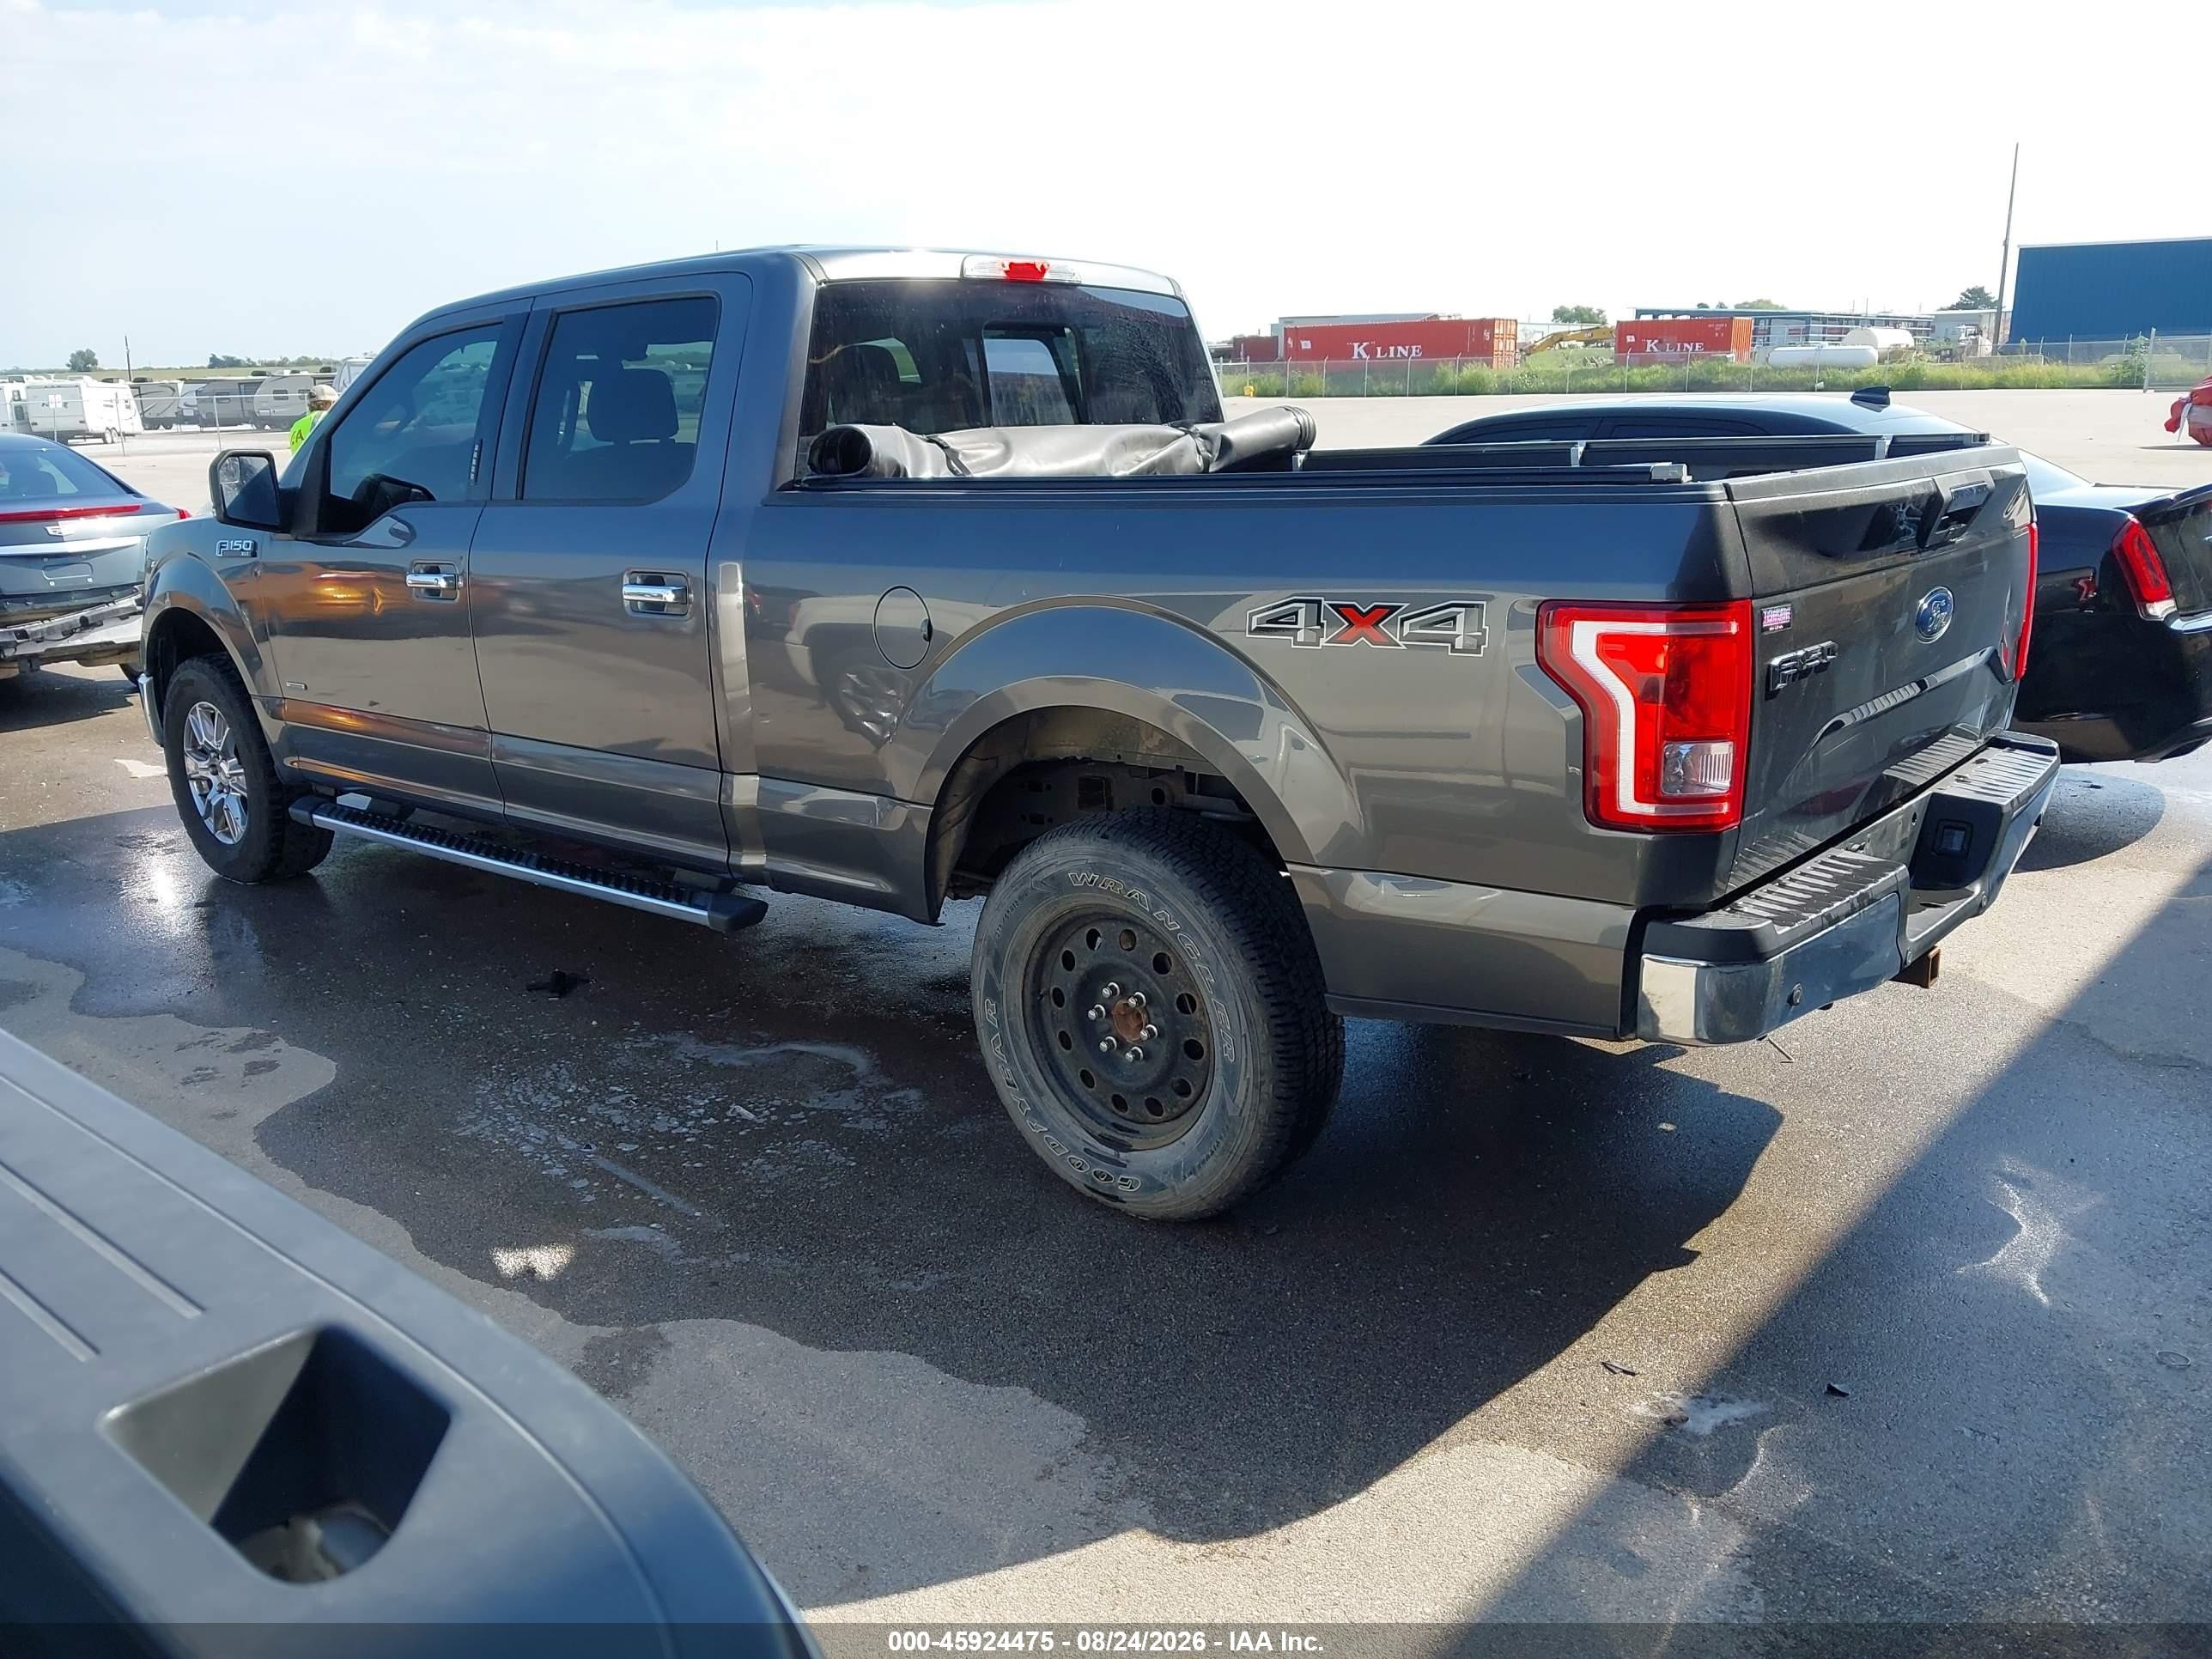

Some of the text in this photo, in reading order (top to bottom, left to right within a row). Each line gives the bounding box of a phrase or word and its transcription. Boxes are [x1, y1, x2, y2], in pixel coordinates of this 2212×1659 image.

[1376, 344, 1423, 358] LINE
[1665, 341, 1705, 352] LINE
[1067, 871, 1236, 1064] WRANGLER
[984, 996, 1142, 1193] GOODYEAR
